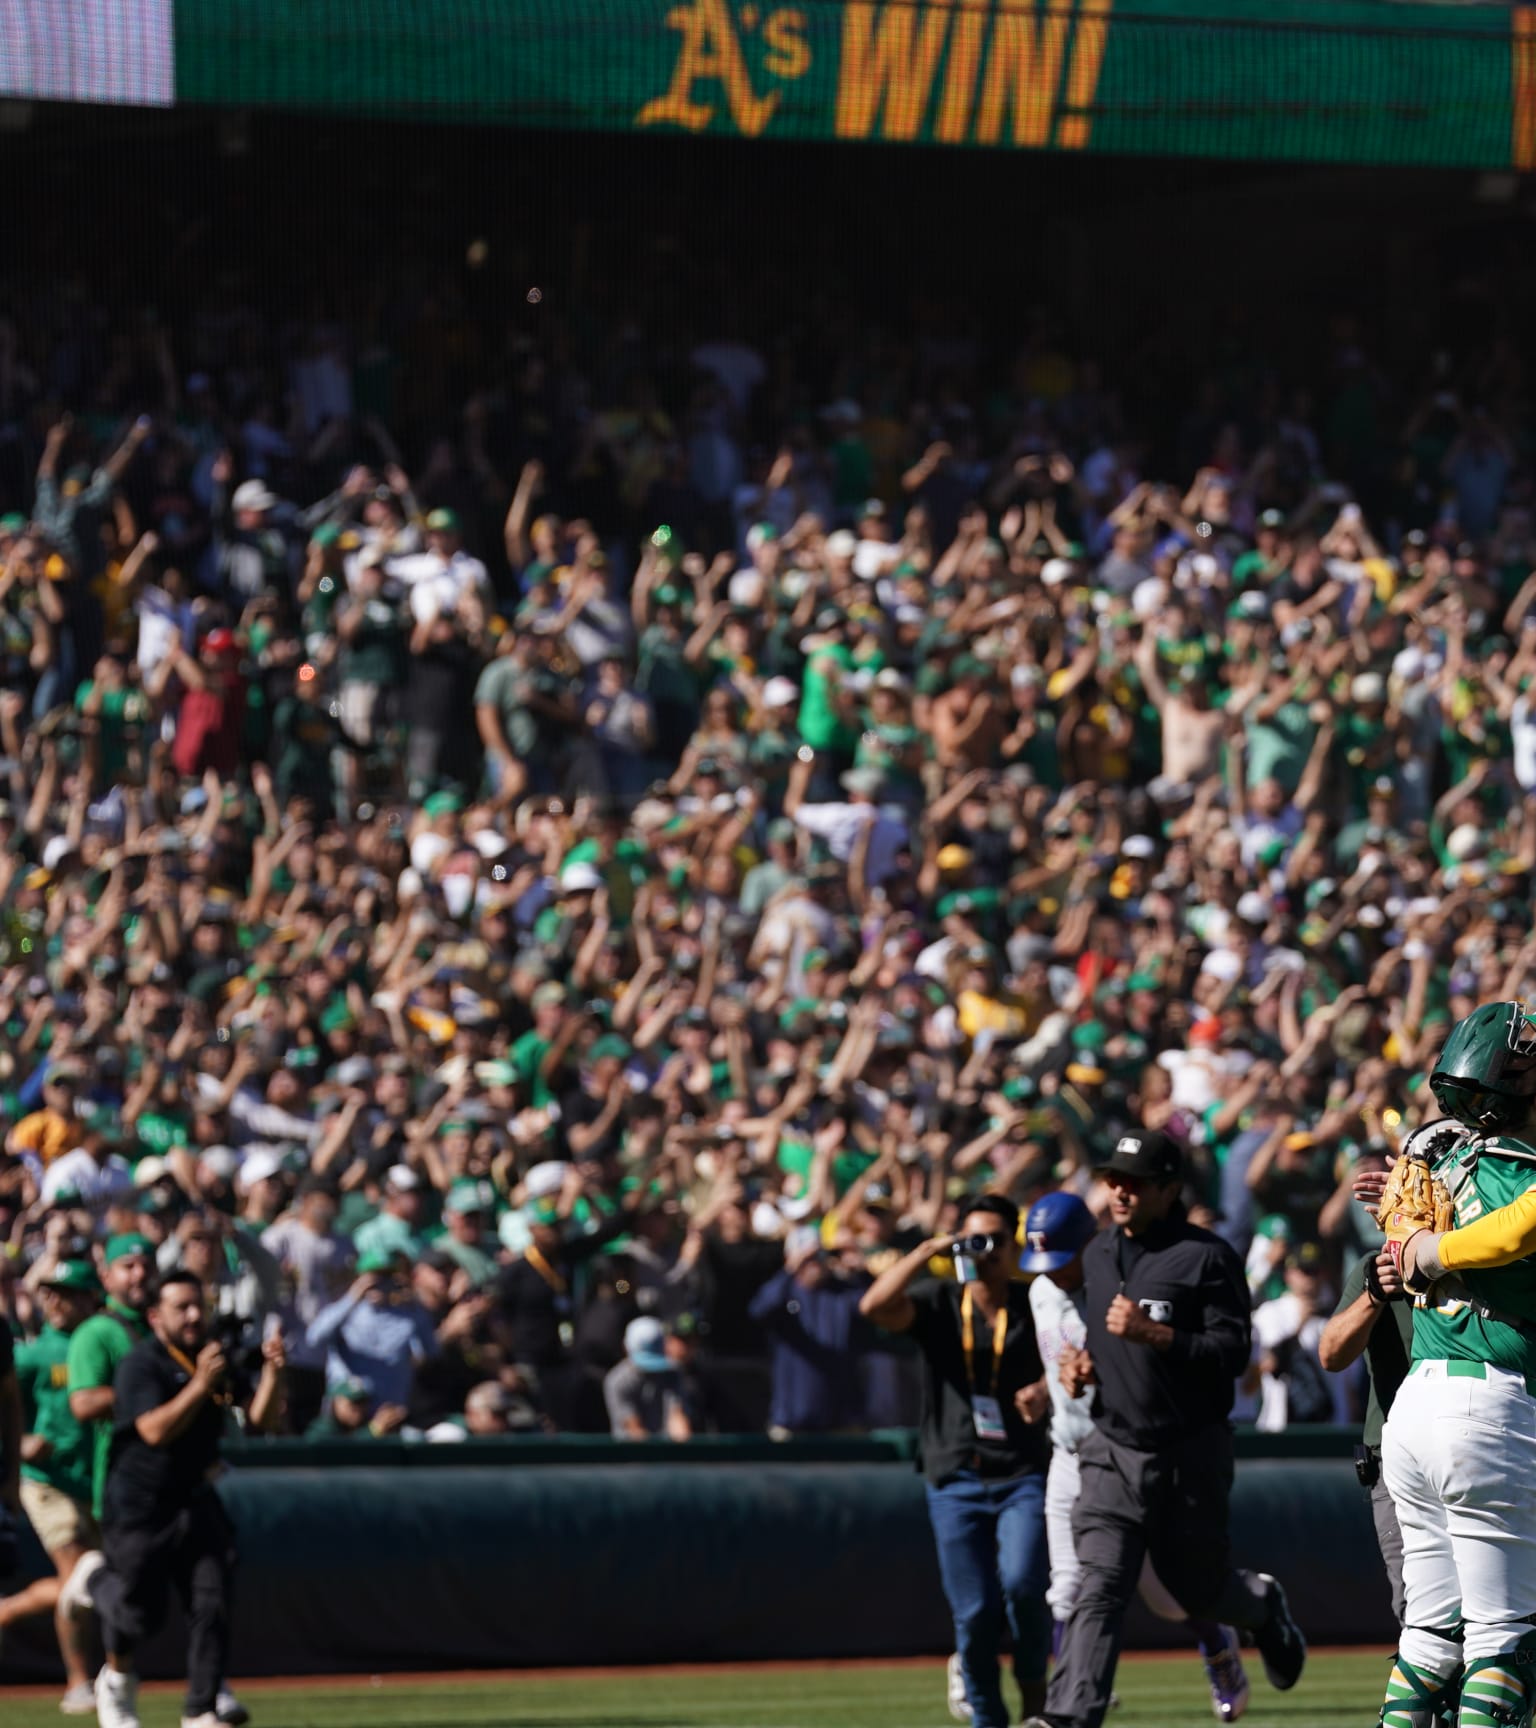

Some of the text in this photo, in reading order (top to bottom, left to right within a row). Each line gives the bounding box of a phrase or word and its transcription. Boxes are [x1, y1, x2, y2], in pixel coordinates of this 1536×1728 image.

[635, 0, 1112, 149] A's WIN!
[1027, 1231, 1048, 1252] T
